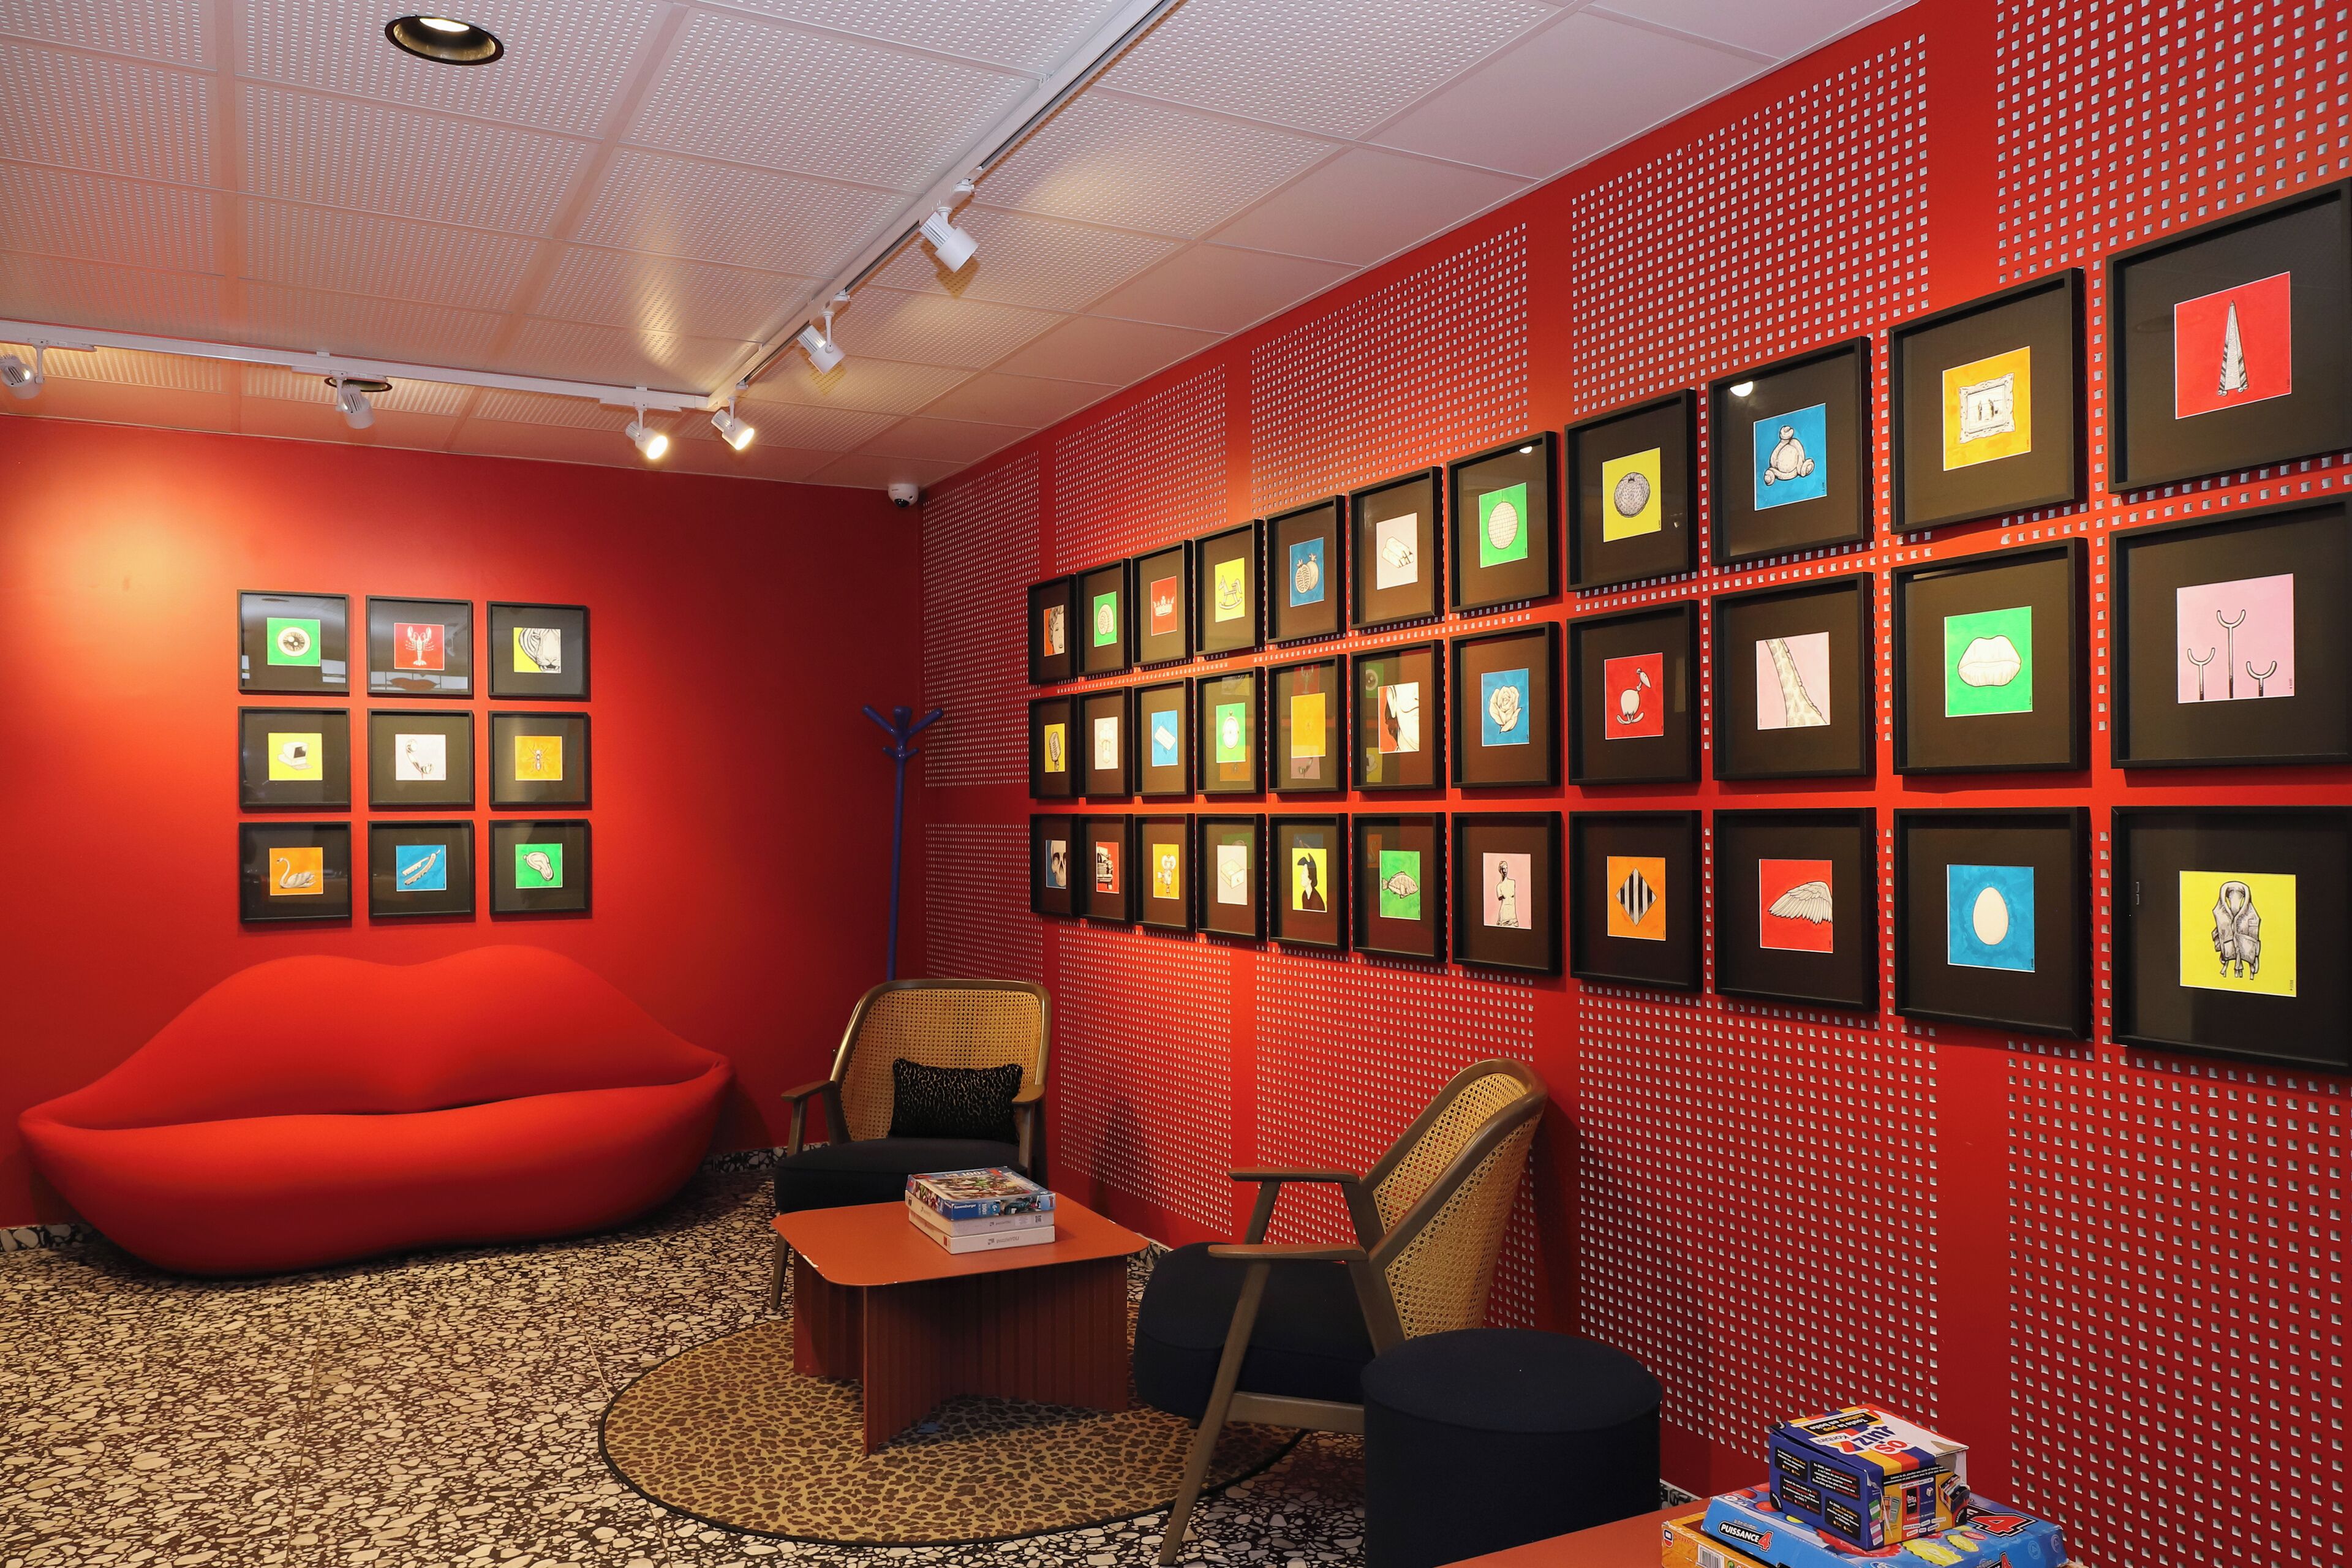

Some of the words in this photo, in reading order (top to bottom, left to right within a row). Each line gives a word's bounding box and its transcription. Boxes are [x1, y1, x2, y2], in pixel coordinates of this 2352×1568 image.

[1970, 1515, 2027, 1534] 4
[1721, 1524, 1760, 1542] PUISSANCE
[1758, 1531, 1772, 1550] 4
